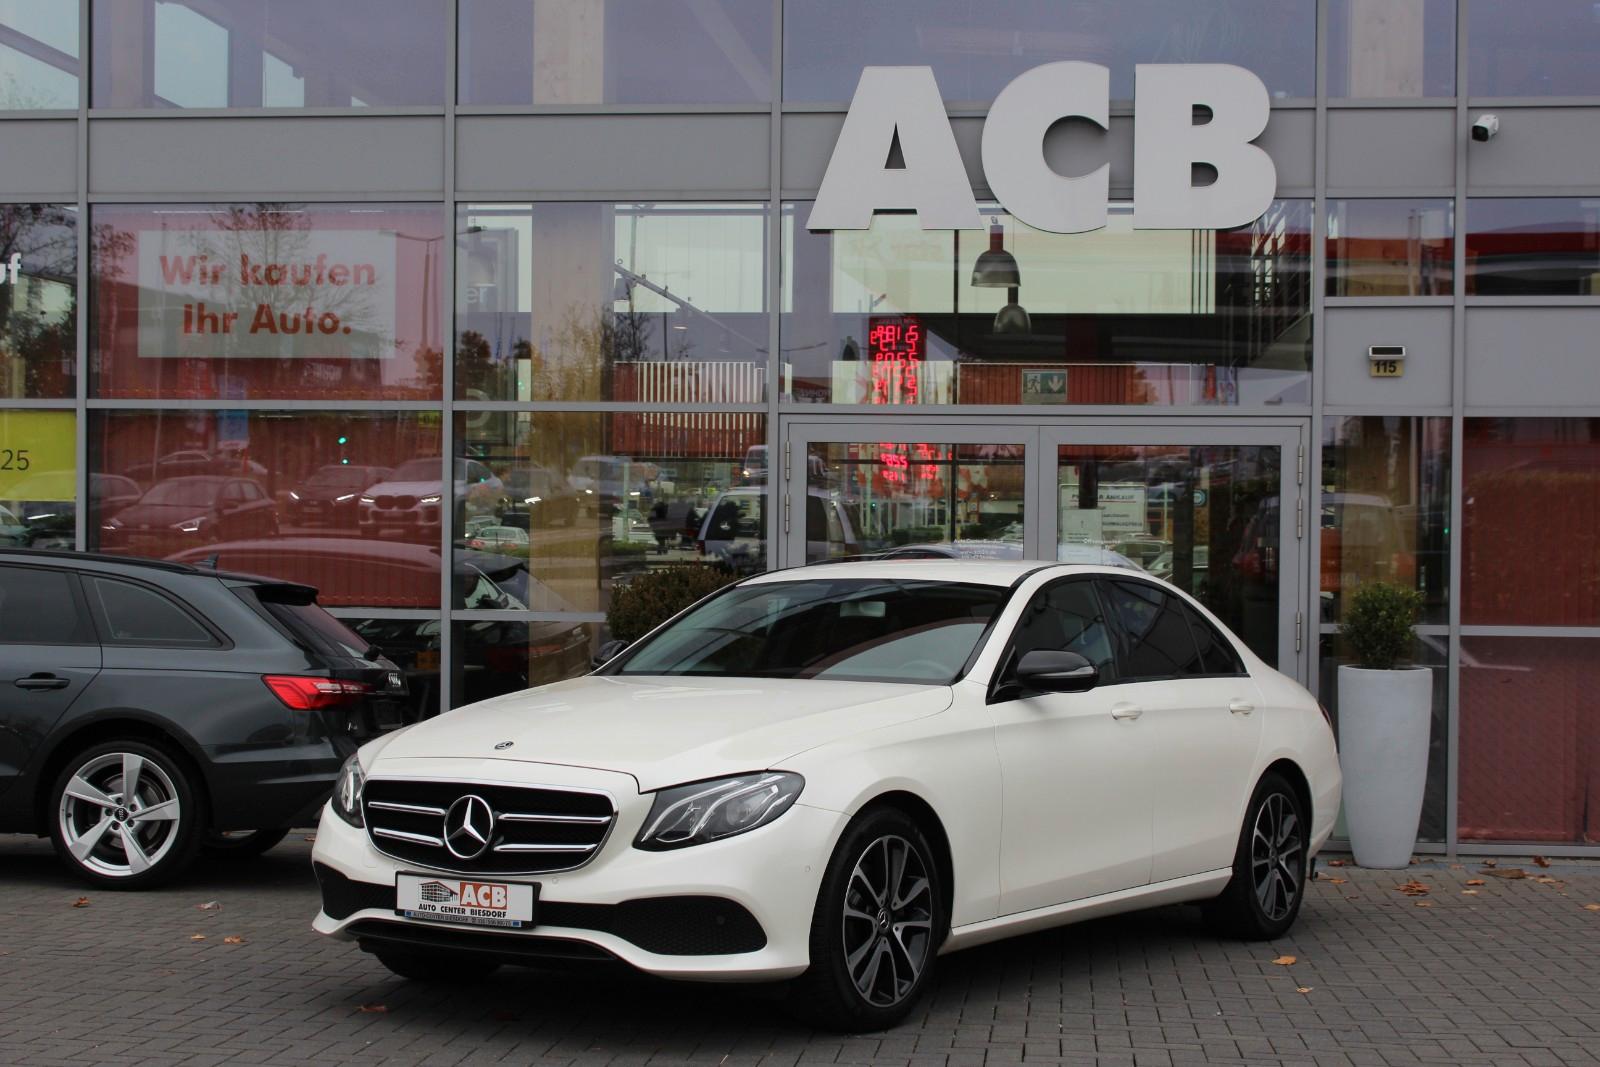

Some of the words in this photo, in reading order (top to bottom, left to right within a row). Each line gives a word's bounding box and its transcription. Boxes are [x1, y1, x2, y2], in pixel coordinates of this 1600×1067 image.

[805, 60, 1277, 234] ACB
[160, 254, 226, 286] Wir
[240, 253, 376, 286] kaufen
[183, 302, 238, 335] Ihr
[250, 303, 352, 335] Auto.
[1374, 360, 1397, 374] 115
[1, 450, 29, 471] 25
[460, 884, 507, 909] ACB
[418, 903, 437, 912] AUTO
[440, 905, 466, 915] CENTER
[470, 909, 507, 919] BIESDORF
